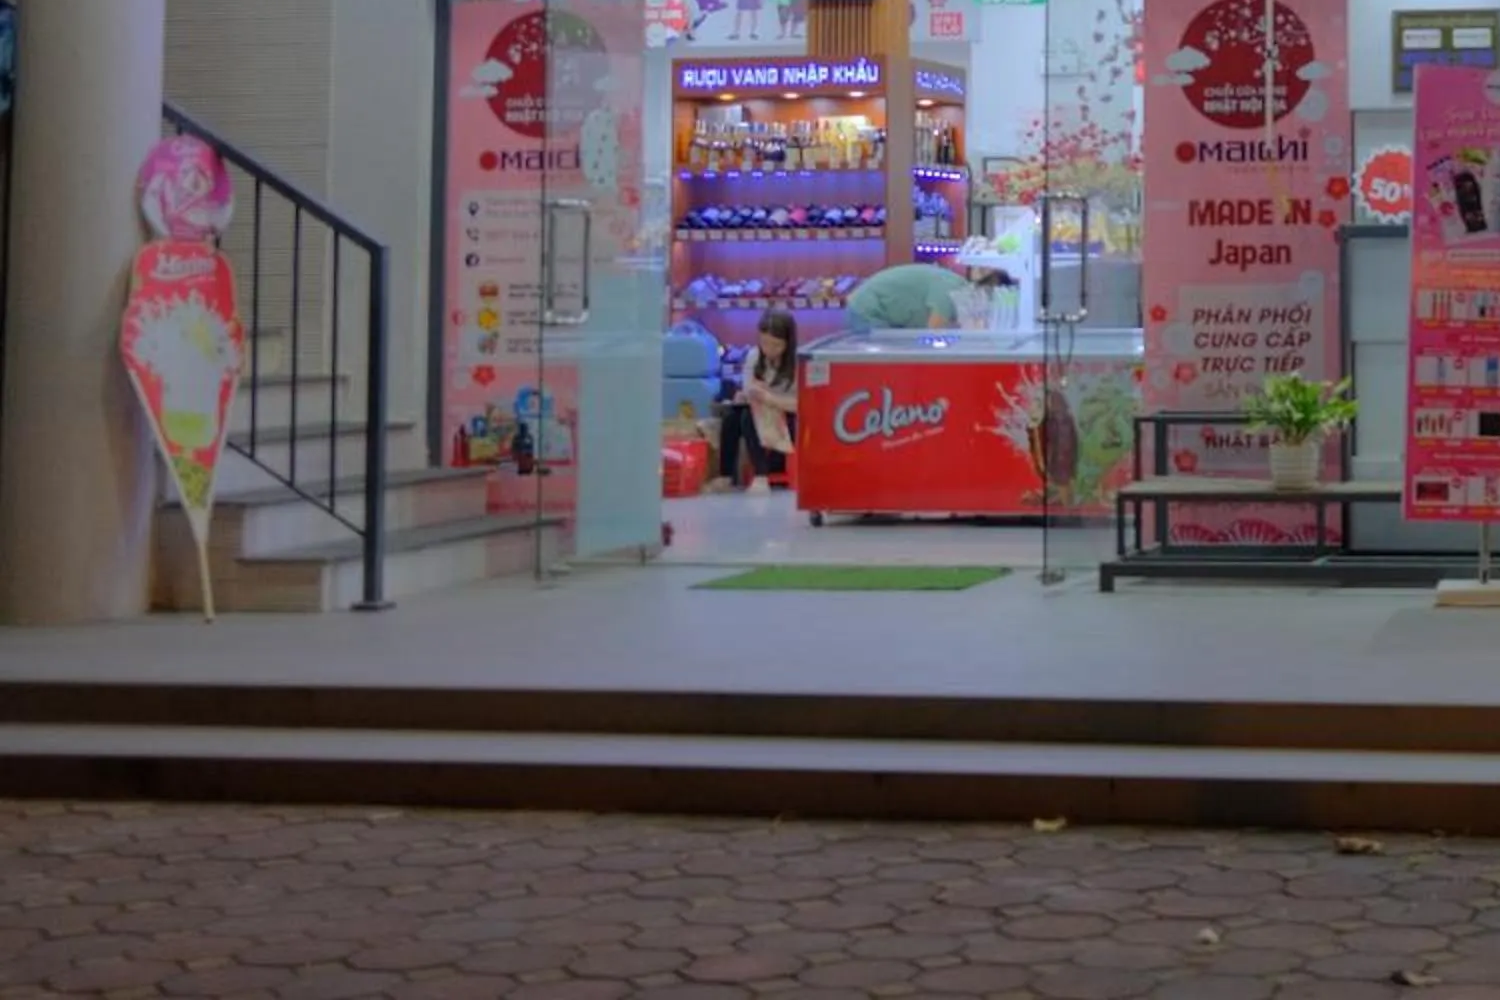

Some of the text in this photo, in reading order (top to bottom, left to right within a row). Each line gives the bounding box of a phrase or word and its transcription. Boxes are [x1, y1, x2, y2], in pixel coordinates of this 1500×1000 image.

[732, 65, 779, 86] VANG
[783, 62, 829, 88] NHẬP
[1188, 199, 1274, 227] MADE
[1208, 239, 1293, 272] Japan
[1191, 304, 1253, 325] PHÂN
[1194, 331, 1259, 349] CUNG
[834, 386, 945, 445] Celano
